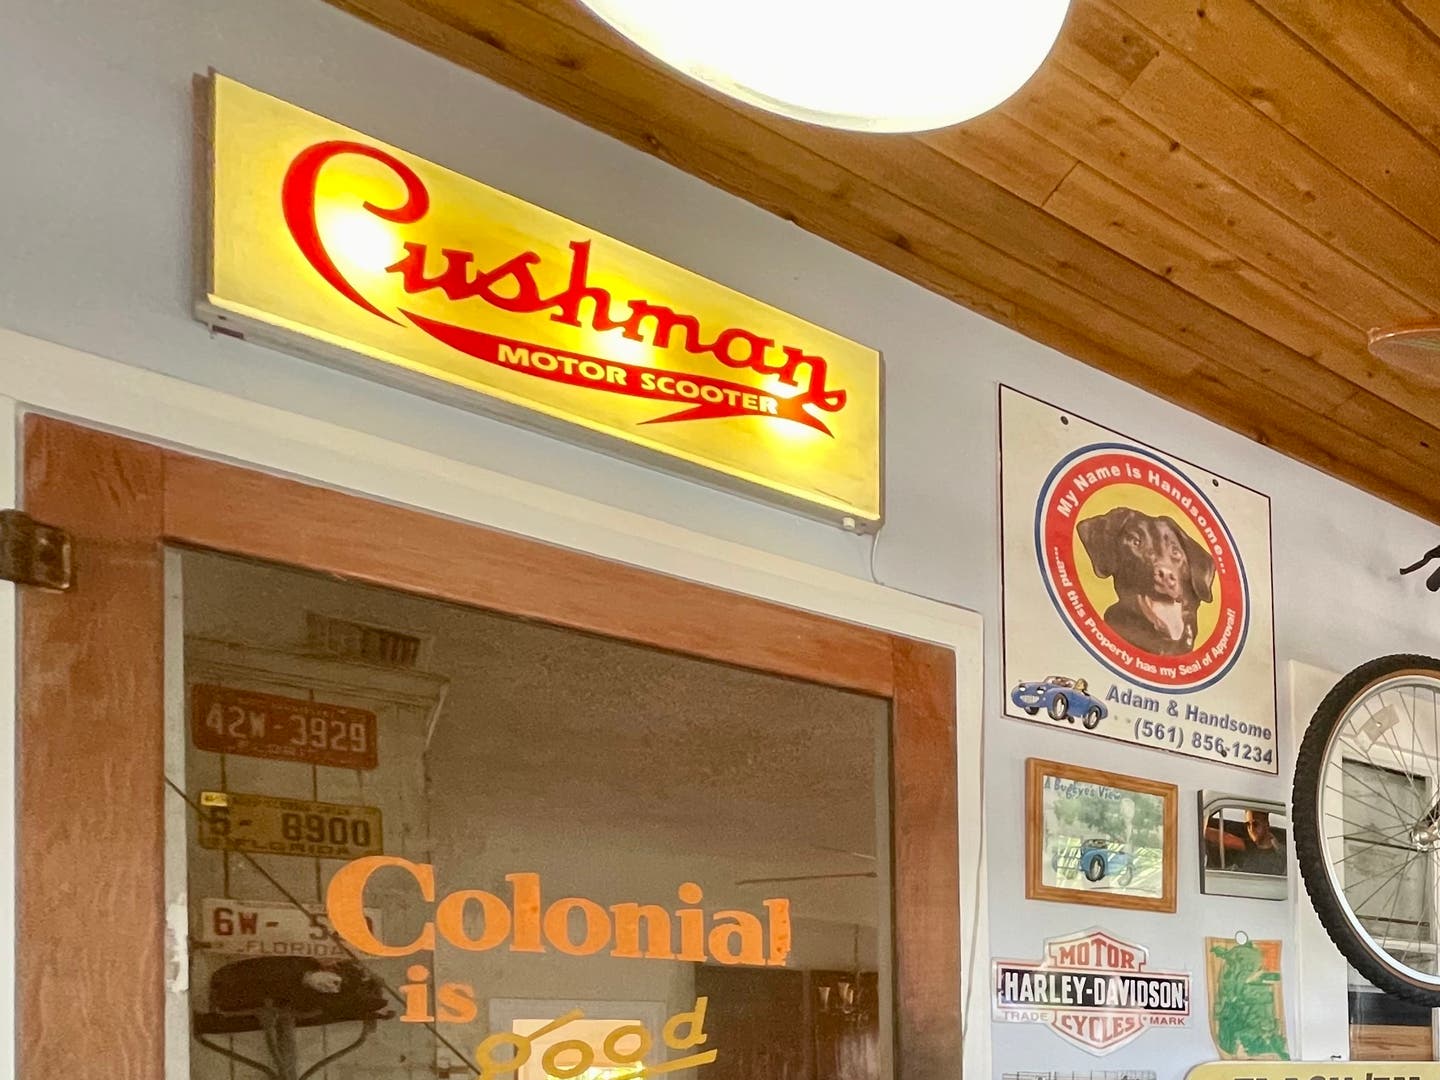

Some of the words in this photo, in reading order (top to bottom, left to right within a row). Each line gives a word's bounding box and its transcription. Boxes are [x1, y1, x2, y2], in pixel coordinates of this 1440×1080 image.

[282, 140, 847, 412] Cushman
[497, 343, 627, 388] MOTOR
[641, 372, 779, 415] SCOOTER
[1057, 489, 1080, 518] My
[1072, 463, 1121, 492] Name
[1126, 463, 1142, 479] is
[1067, 589, 1086, 618] this
[1085, 617, 1133, 665] Property
[1135, 656, 1158, 675] has
[1160, 664, 1177, 679] my
[1178, 659, 1202, 675] Seal
[1202, 651, 1213, 667] of
[1105, 684, 1160, 713] Adam
[1166, 699, 1179, 718] &
[1185, 703, 1272, 741] Handsome
[1134, 717, 1185, 750] (561)
[1191, 732, 1273, 766] 856-1234
[325, 855, 793, 967] Colonial
[1059, 938, 1135, 969] MOTOR
[399, 966, 477, 1024] is
[1004, 972, 1184, 1009] HARLEY-DAVIDSON
[1002, 1010, 1049, 1022] TRADE
[1061, 1015, 1136, 1042] CYCLES
[1150, 1016, 1185, 1026] MARK
